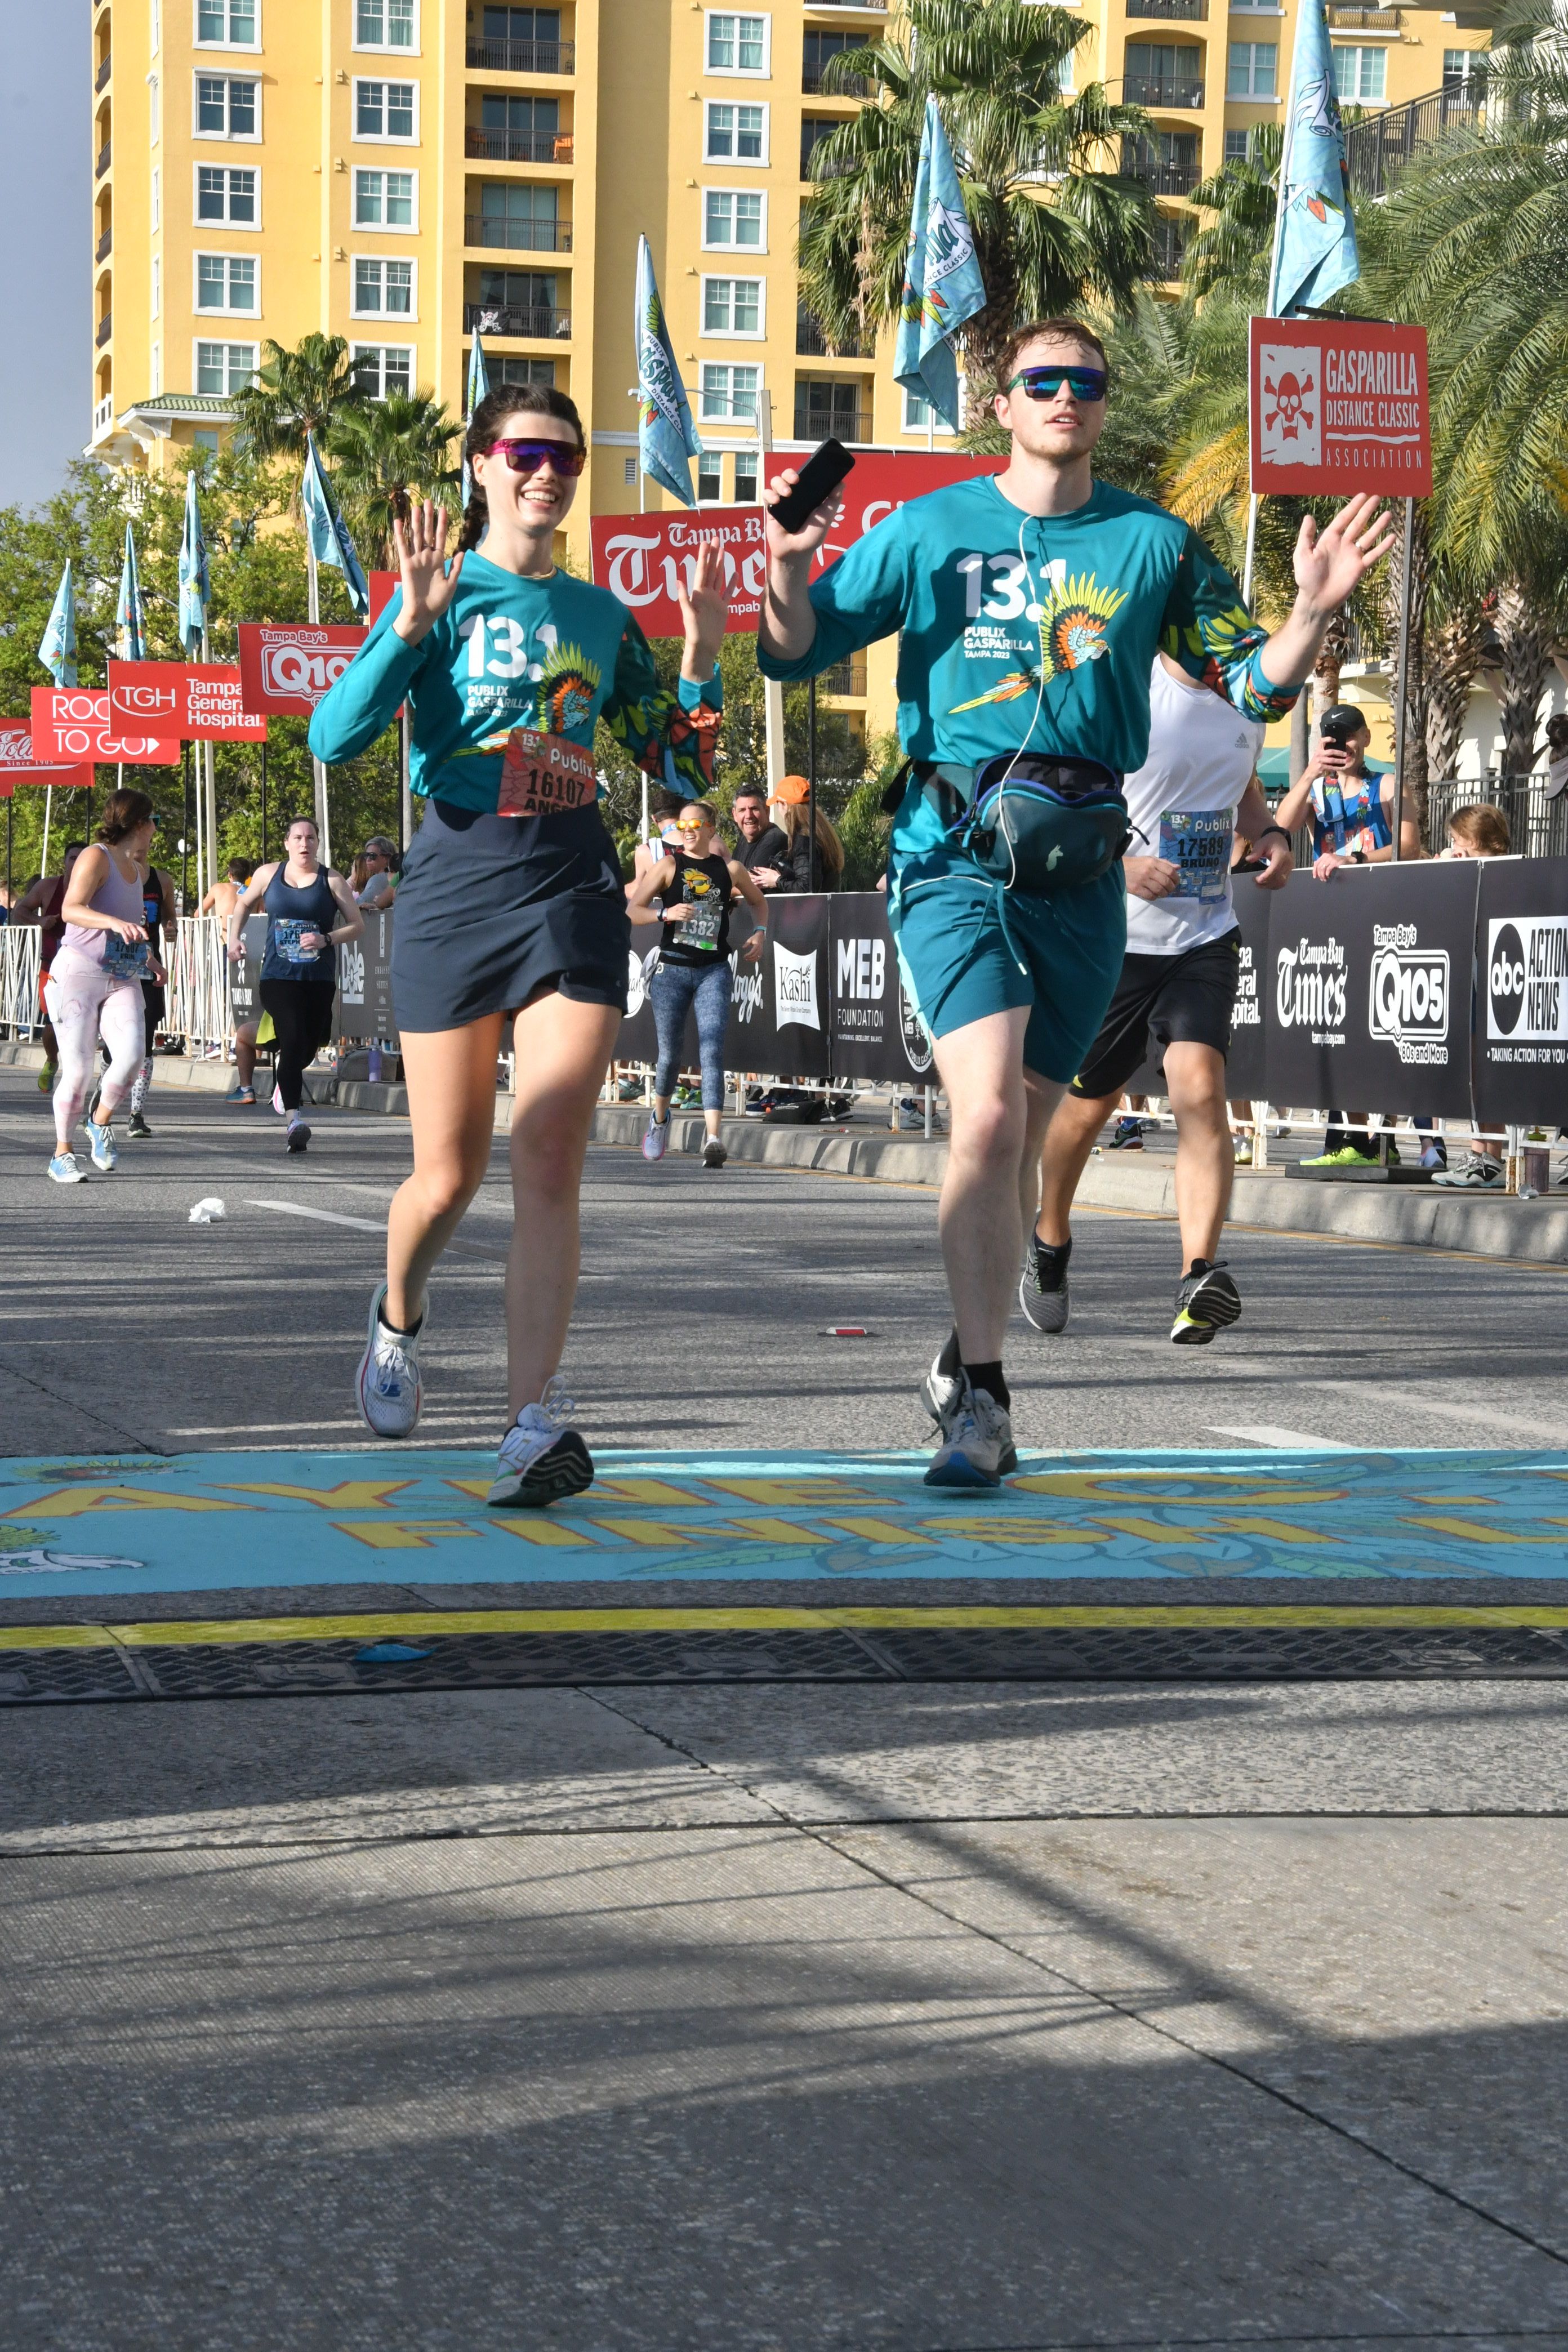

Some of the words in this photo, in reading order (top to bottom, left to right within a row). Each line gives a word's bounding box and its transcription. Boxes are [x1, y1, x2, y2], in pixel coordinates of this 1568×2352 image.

[943, 248, 968, 273] CLASSIC
[646, 335, 665, 358] PUBLIX
[1326, 349, 1418, 395] GASPARILLA
[651, 388, 674, 420] DISTANCE
[1326, 400, 1374, 426] DISTANCE
[1378, 402, 1420, 428] CLASSIC
[1326, 448, 1422, 468] ASSOCIATION
[668, 522, 742, 548] Tampa
[956, 553, 1066, 622] 13.1
[260, 630, 297, 642] Tampa
[299, 630, 328, 644] Bay's
[964, 626, 1006, 638] PUBLIX
[458, 613, 559, 682] 13.1
[964, 638, 1034, 651] GASPARILLA
[964, 650, 991, 658] TAMPA
[271, 646, 351, 694] Q10
[120, 686, 176, 707] TGH
[187, 694, 243, 711] Gener
[467, 685, 509, 696] PUBLIX
[467, 697, 533, 710] GASPARILLA
[188, 710, 260, 729] Hospital
[53, 729, 90, 754] TO
[96, 730, 146, 755] GO
[523, 733, 540, 748] 13.1
[550, 748, 593, 779] Publix
[527, 769, 585, 807] 16107
[1171, 814, 1186, 823] 13.1
[1195, 818, 1230, 832] Publix
[1177, 836, 1223, 857] 17589
[1181, 857, 1219, 868] BRUNO
[1374, 924, 1397, 946] Tampa
[1397, 924, 1417, 948] Bay's
[342, 940, 364, 993] Dole
[1299, 937, 1327, 974] Tampa
[1327, 937, 1344, 970] Bay
[1492, 951, 1524, 996] abc
[1529, 928, 1568, 978] ACTION
[838, 939, 885, 999] MEB
[779, 966, 811, 1002] Kashi
[1277, 946, 1348, 1028] Times
[1376, 953, 1444, 1036] Q105
[838, 1008, 884, 1027] FOUNDATION
[1527, 981, 1560, 1031] NEWS
[1312, 1031, 1346, 1047] tampabay.com
[1415, 1043, 1429, 1063] and
[1429, 1044, 1448, 1064] More
[1491, 1048, 1513, 1062] TAKING
[1513, 1048, 1537, 1063] ACTION
[1538, 1049, 1551, 1063] FOR
[1552, 1049, 1566, 1063] YOU
[327, 1517, 1352, 1549] FINISH
